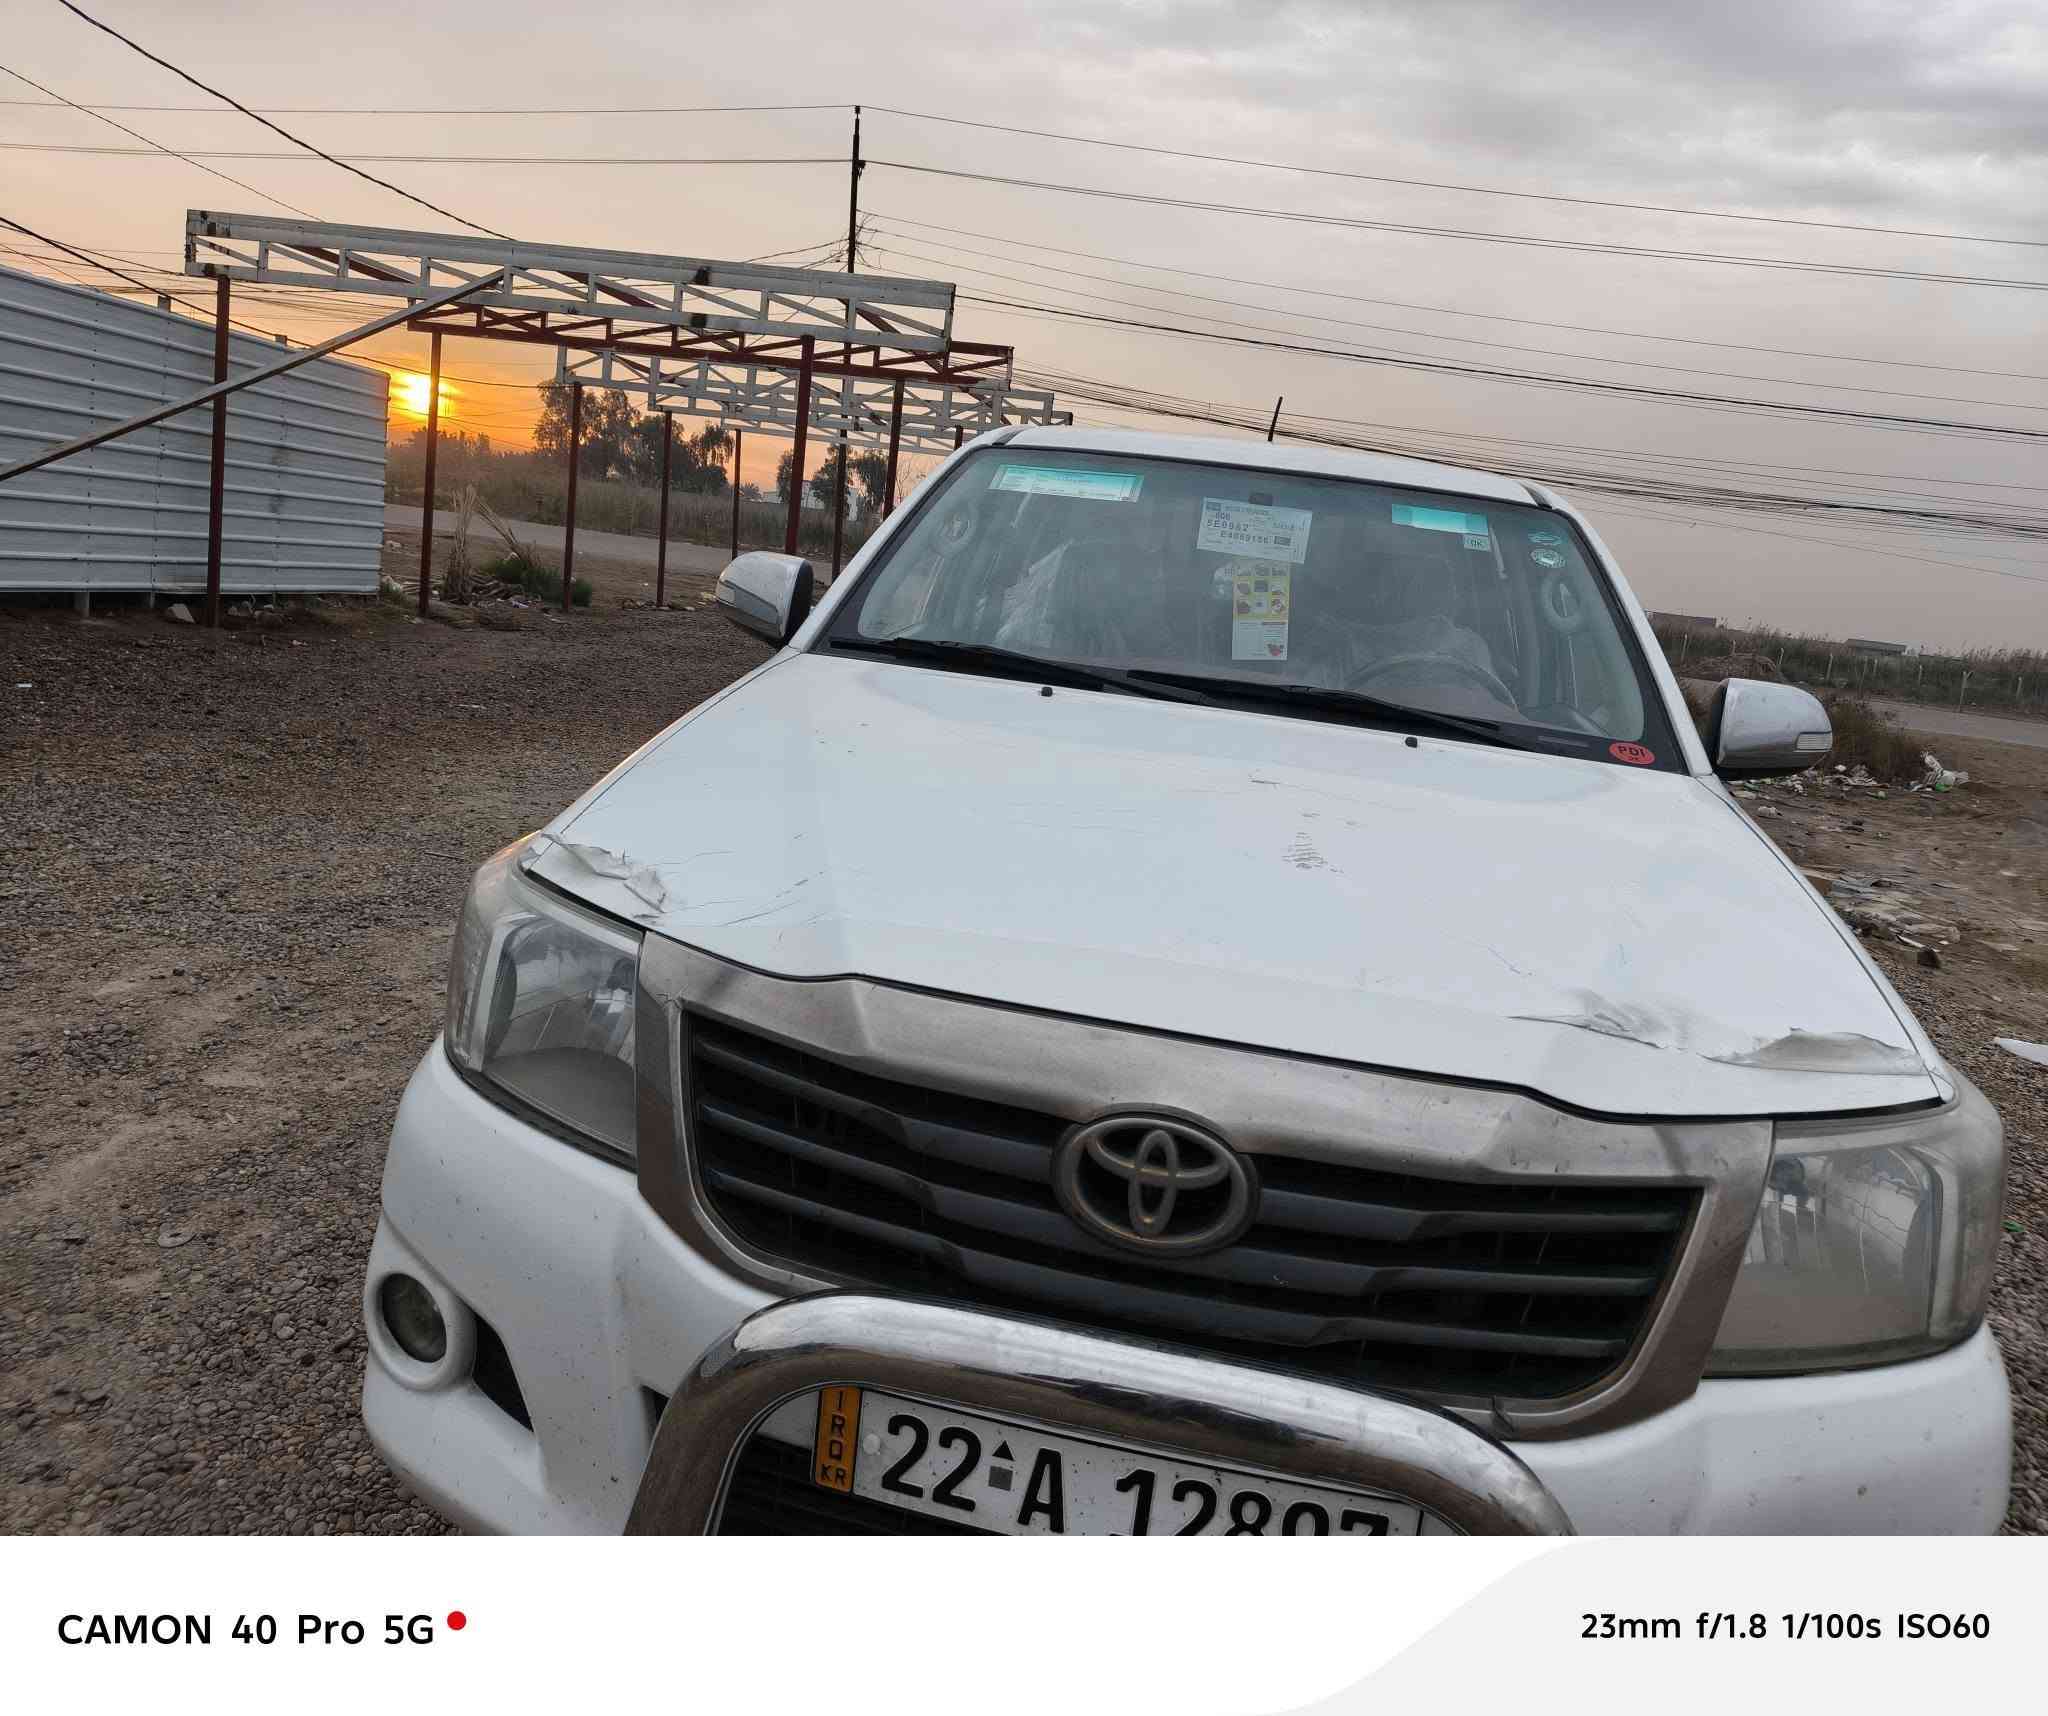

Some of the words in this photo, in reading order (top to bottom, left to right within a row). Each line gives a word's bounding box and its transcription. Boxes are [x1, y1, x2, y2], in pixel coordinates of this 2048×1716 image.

[1617, 745, 1645, 758] PDI
[821, 1463, 846, 1487] KR
[881, 1414, 981, 1512] 22
[1017, 1447, 1065, 1534] A
